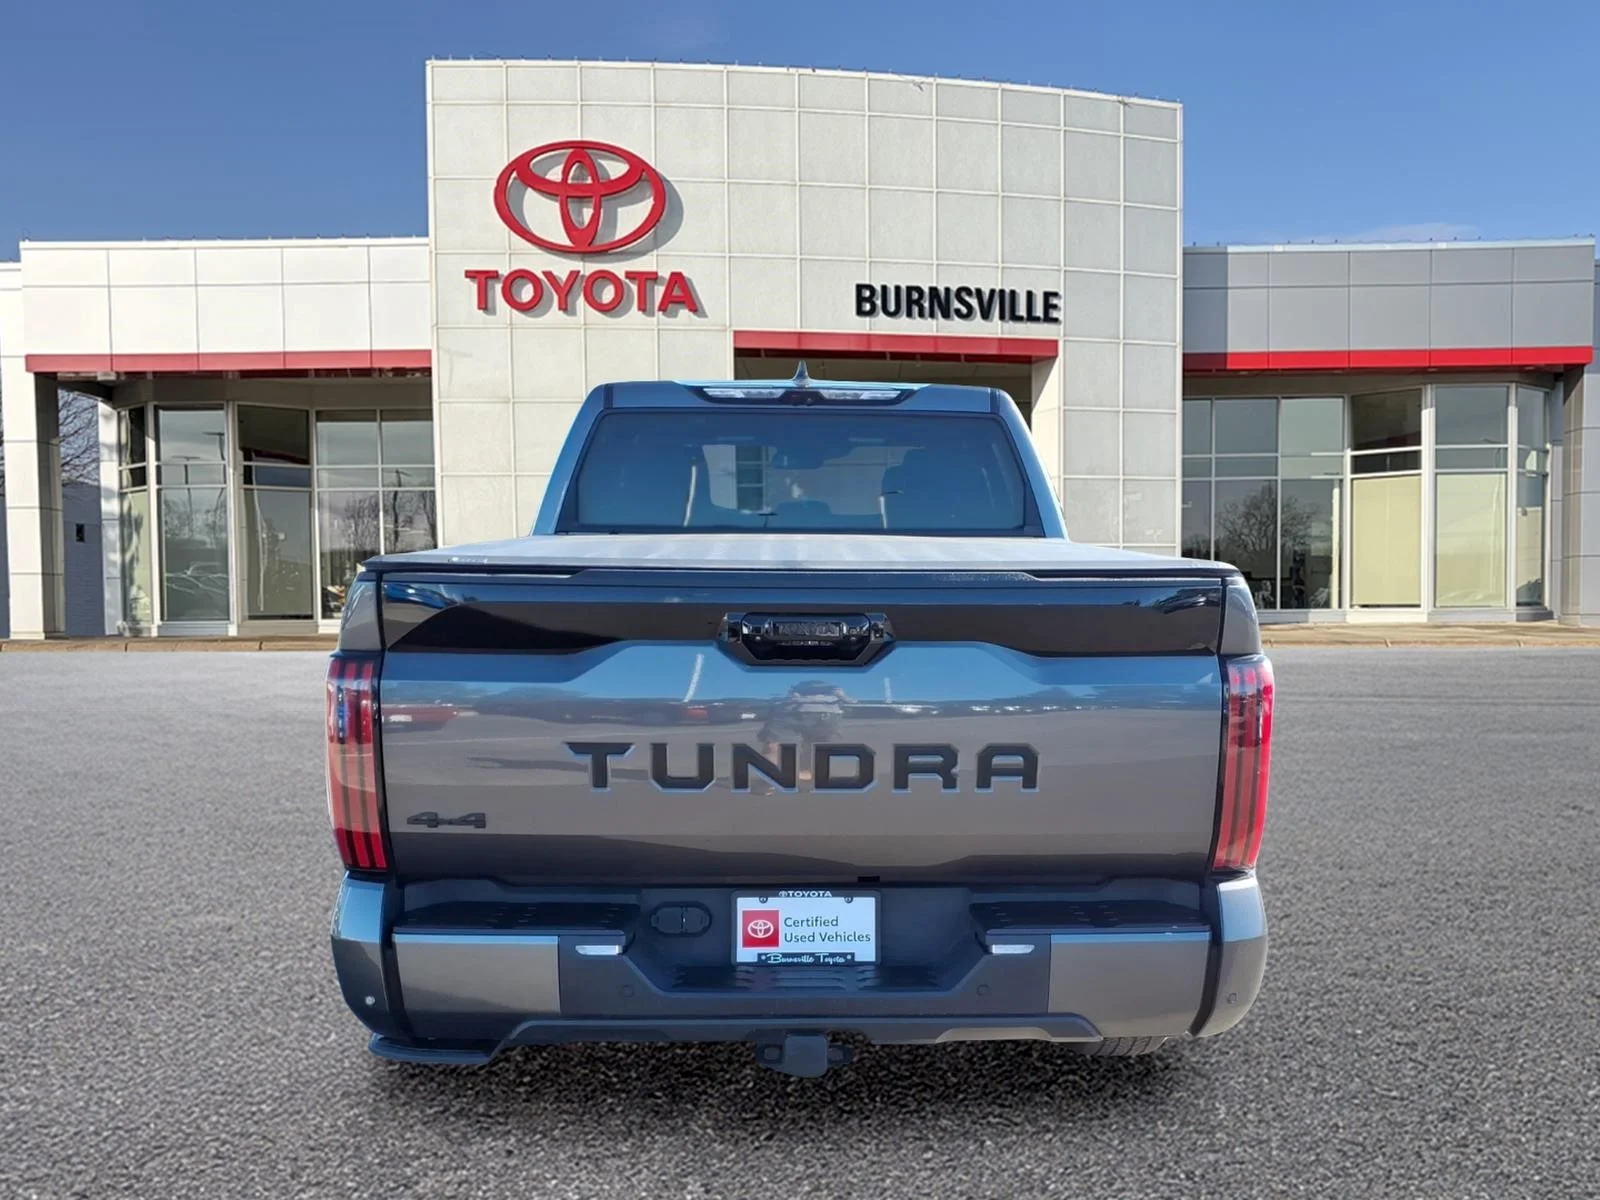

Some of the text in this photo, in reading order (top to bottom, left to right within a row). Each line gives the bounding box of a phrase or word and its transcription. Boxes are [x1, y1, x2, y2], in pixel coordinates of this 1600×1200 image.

[464, 269, 698, 313] TOYOTA
[855, 283, 1061, 324] BURNSVILLE
[565, 742, 1039, 793] TUNDRA
[787, 890, 833, 898] TOYOTA
[783, 915, 839, 928] Certified
[783, 931, 871, 943] Used Vehicles
